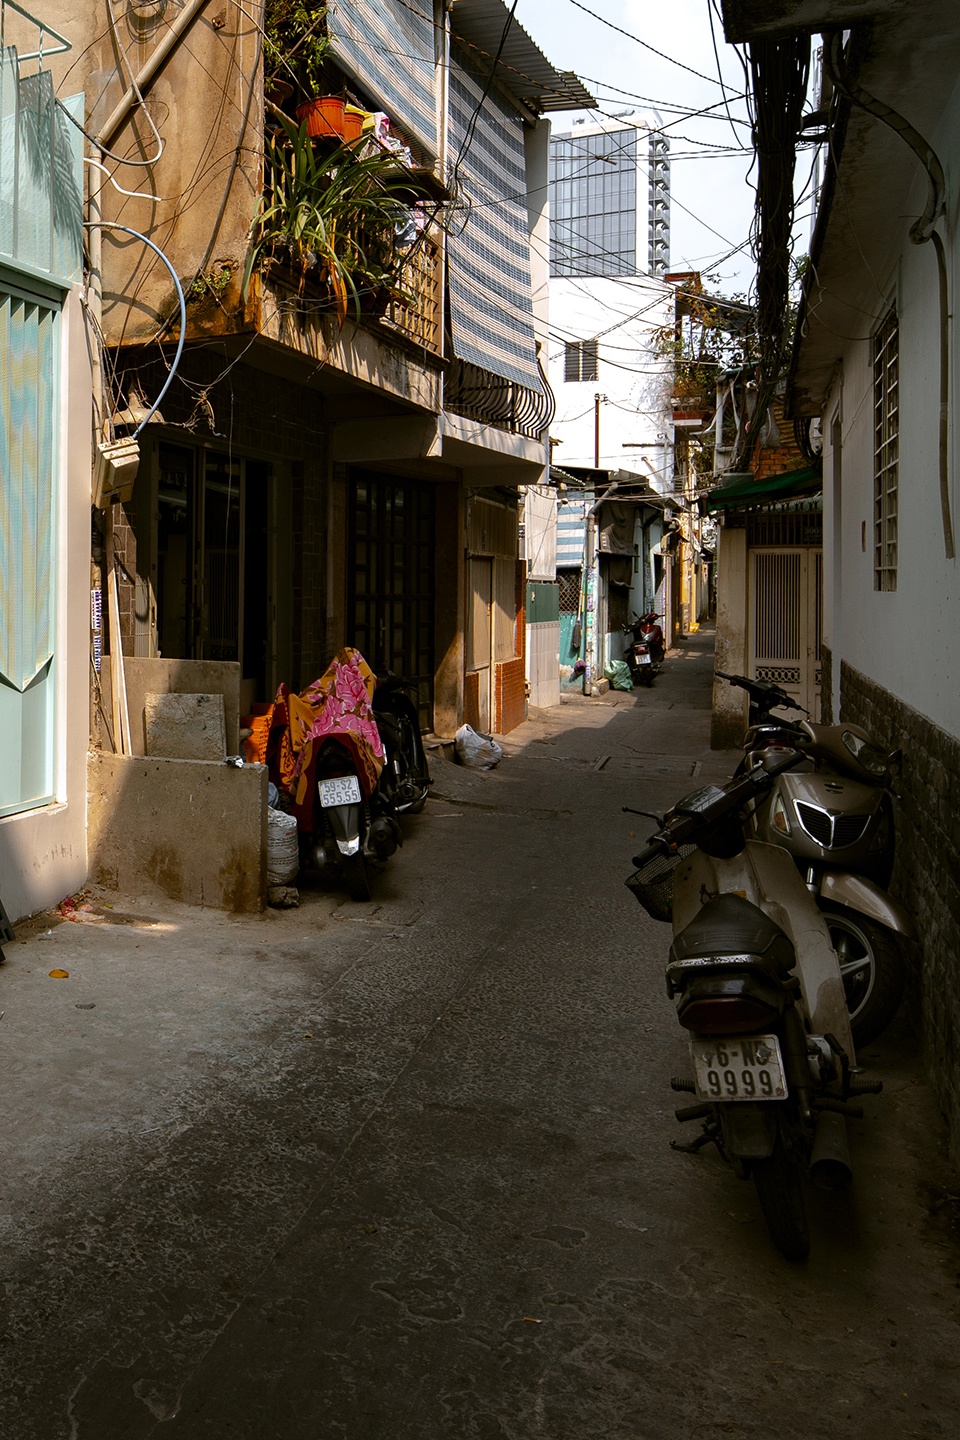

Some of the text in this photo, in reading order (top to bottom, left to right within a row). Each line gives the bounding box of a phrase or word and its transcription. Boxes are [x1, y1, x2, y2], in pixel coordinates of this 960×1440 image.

[324, 779, 353, 793] 59-S2
[323, 789, 358, 805] 555.55
[707, 1069, 774, 1097] 9999
